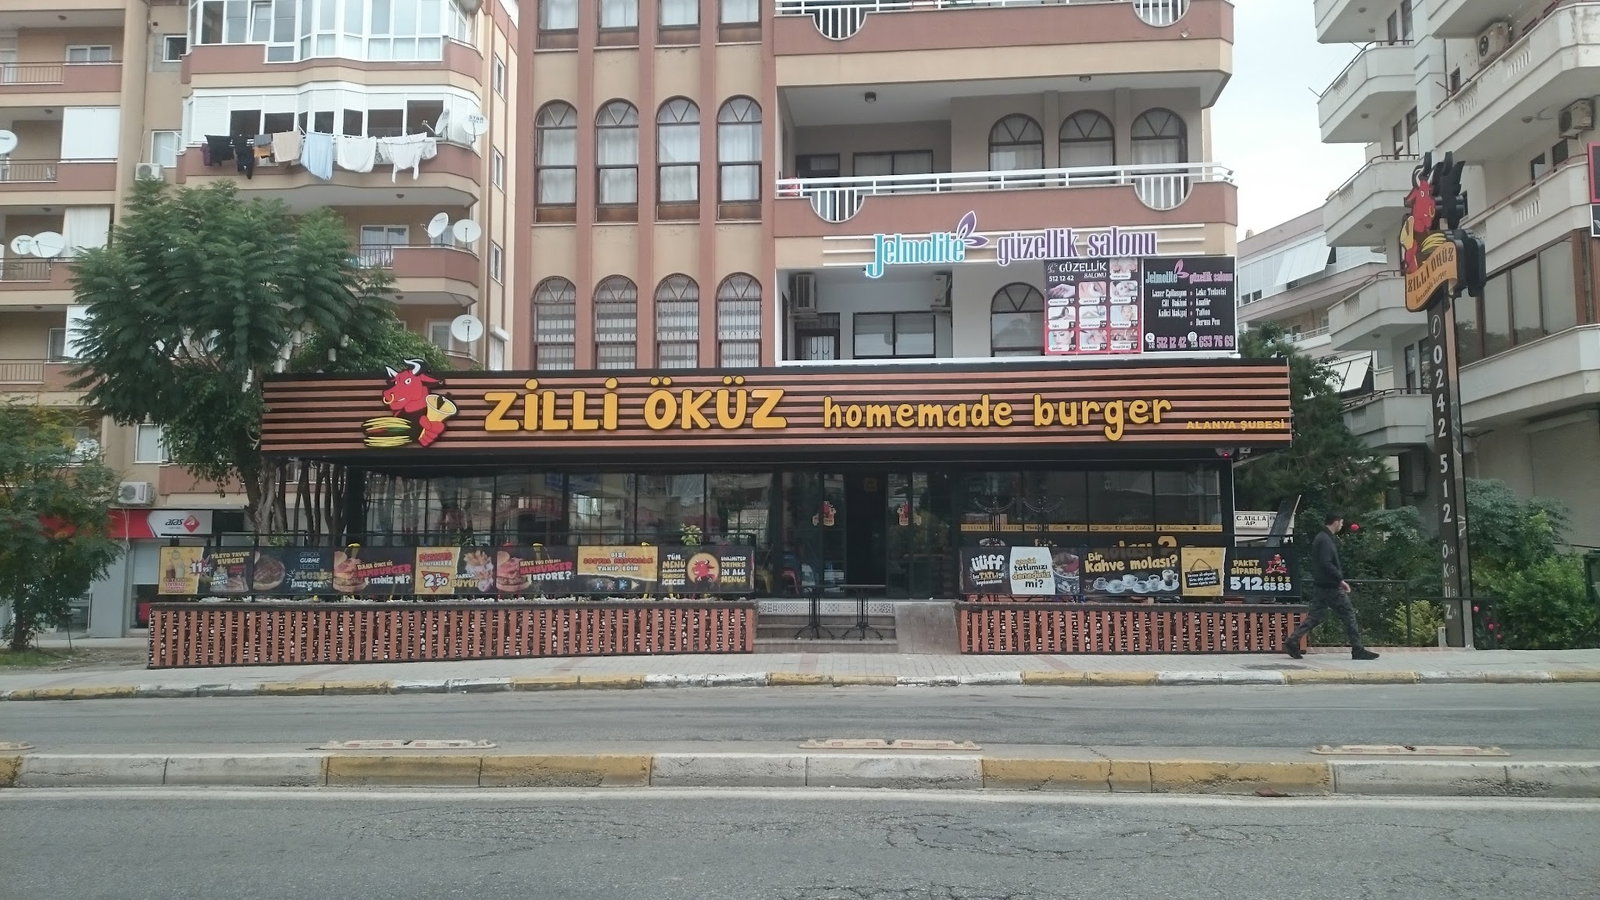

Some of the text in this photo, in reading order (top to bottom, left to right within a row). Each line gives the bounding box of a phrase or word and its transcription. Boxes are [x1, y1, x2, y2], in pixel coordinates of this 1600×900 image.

[866, 226, 1158, 279] Jelmolite güzellik salonu
[1059, 260, 1107, 273] GÜZELLİK
[1145, 271, 1178, 284] Jelmolite
[1189, 271, 1213, 284] güzellik
[1156, 336, 1168, 349] 512
[1169, 336, 1177, 349] 12
[1177, 336, 1187, 349] 42
[1198, 335, 1213, 348] 653
[1213, 335, 1224, 347] 76
[1224, 335, 1234, 347] 69
[484, 375, 1285, 442] ZİLLİ ÖKÜZ homemade burger ALANYA ŞUBESİ
[217, 557, 245, 565] BURGER
[1088, 552, 1103, 561] Bir
[191, 562, 202, 573] 11
[662, 558, 686, 569] MENÜ
[1084, 554, 1178, 573] kahve molası?
[1232, 559, 1260, 567] PAKET
[1230, 566, 1263, 576] SİPARİŞ
[291, 579, 324, 591] burger
[1025, 579, 1044, 588] mi?
[1230, 576, 1263, 591] 512
